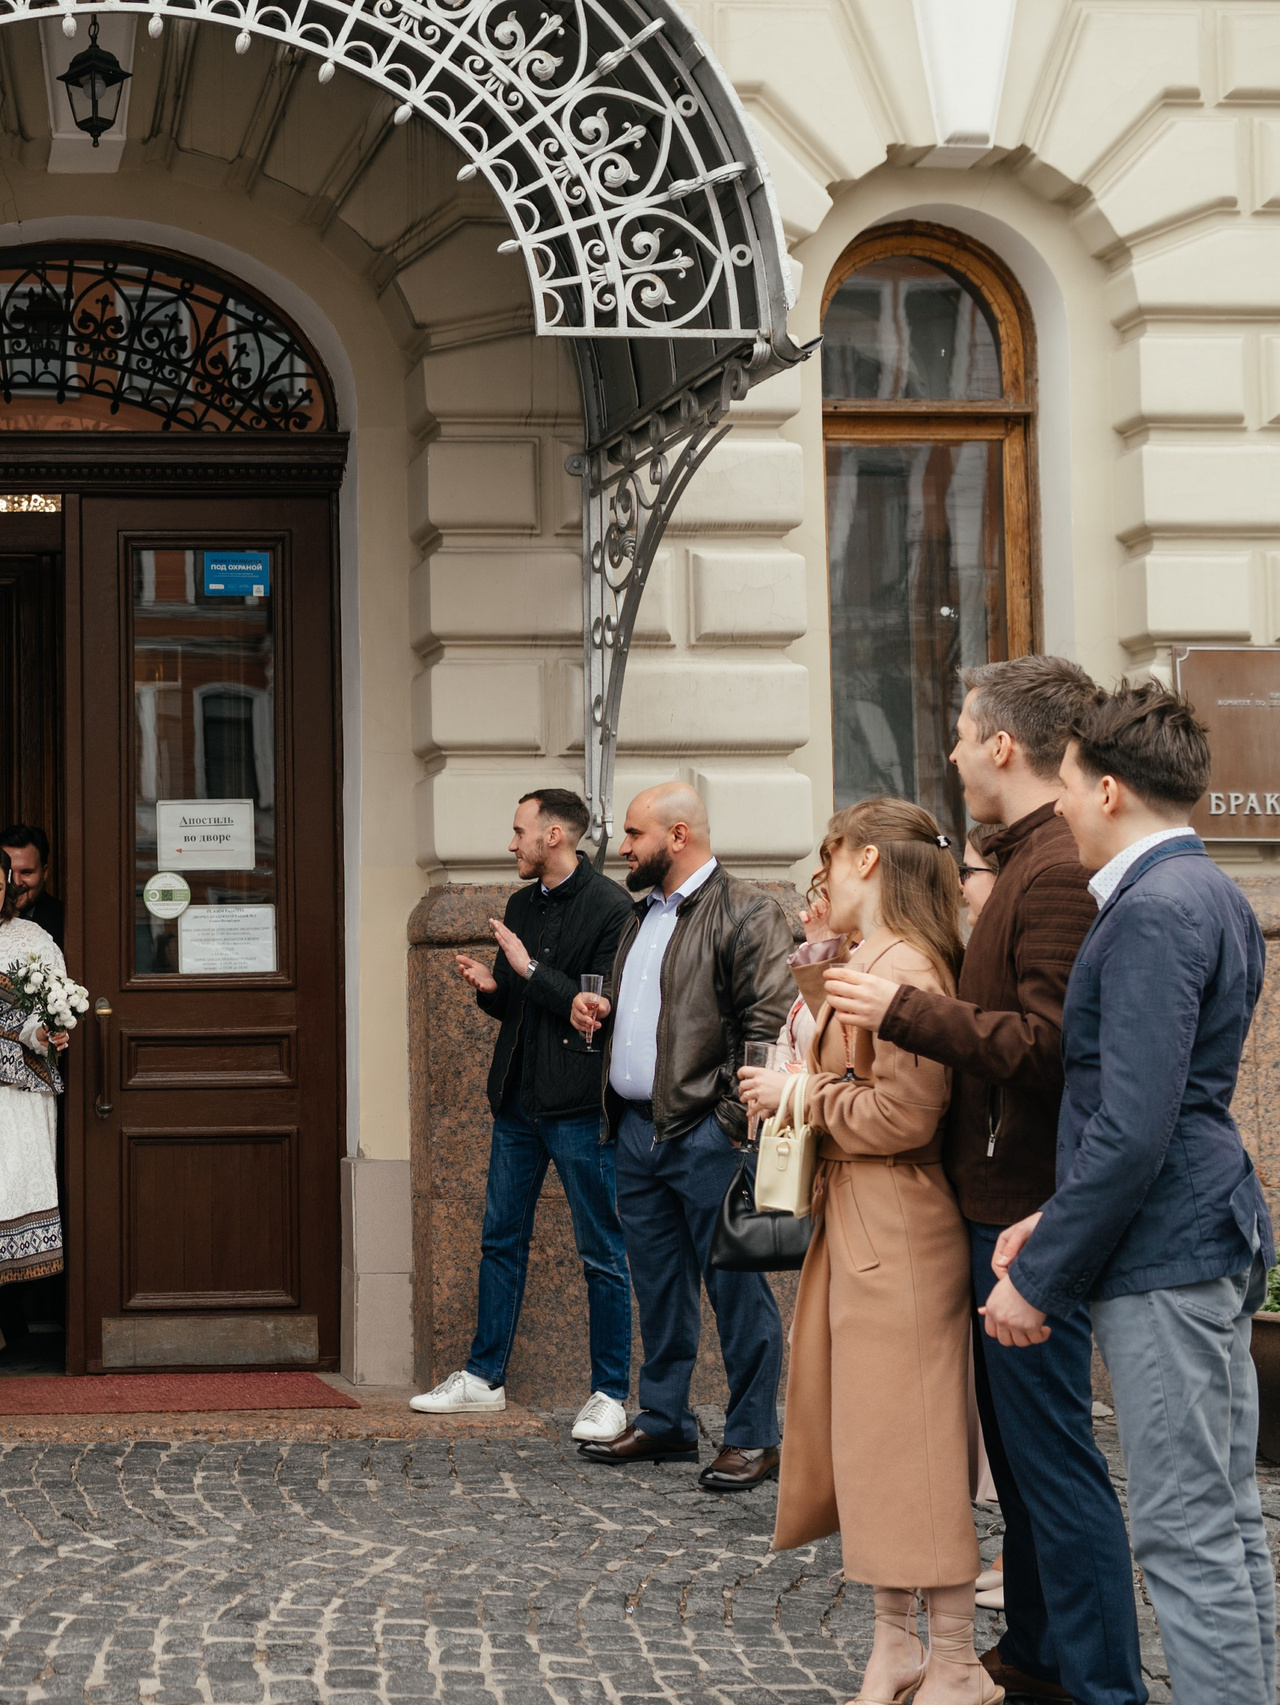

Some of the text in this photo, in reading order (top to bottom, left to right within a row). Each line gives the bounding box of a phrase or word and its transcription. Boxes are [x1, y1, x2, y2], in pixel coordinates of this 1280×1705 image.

[1208, 792, 1280, 816] БРАК
[180, 816, 234, 825] Апостиль
[199, 834, 231, 844] дворе
